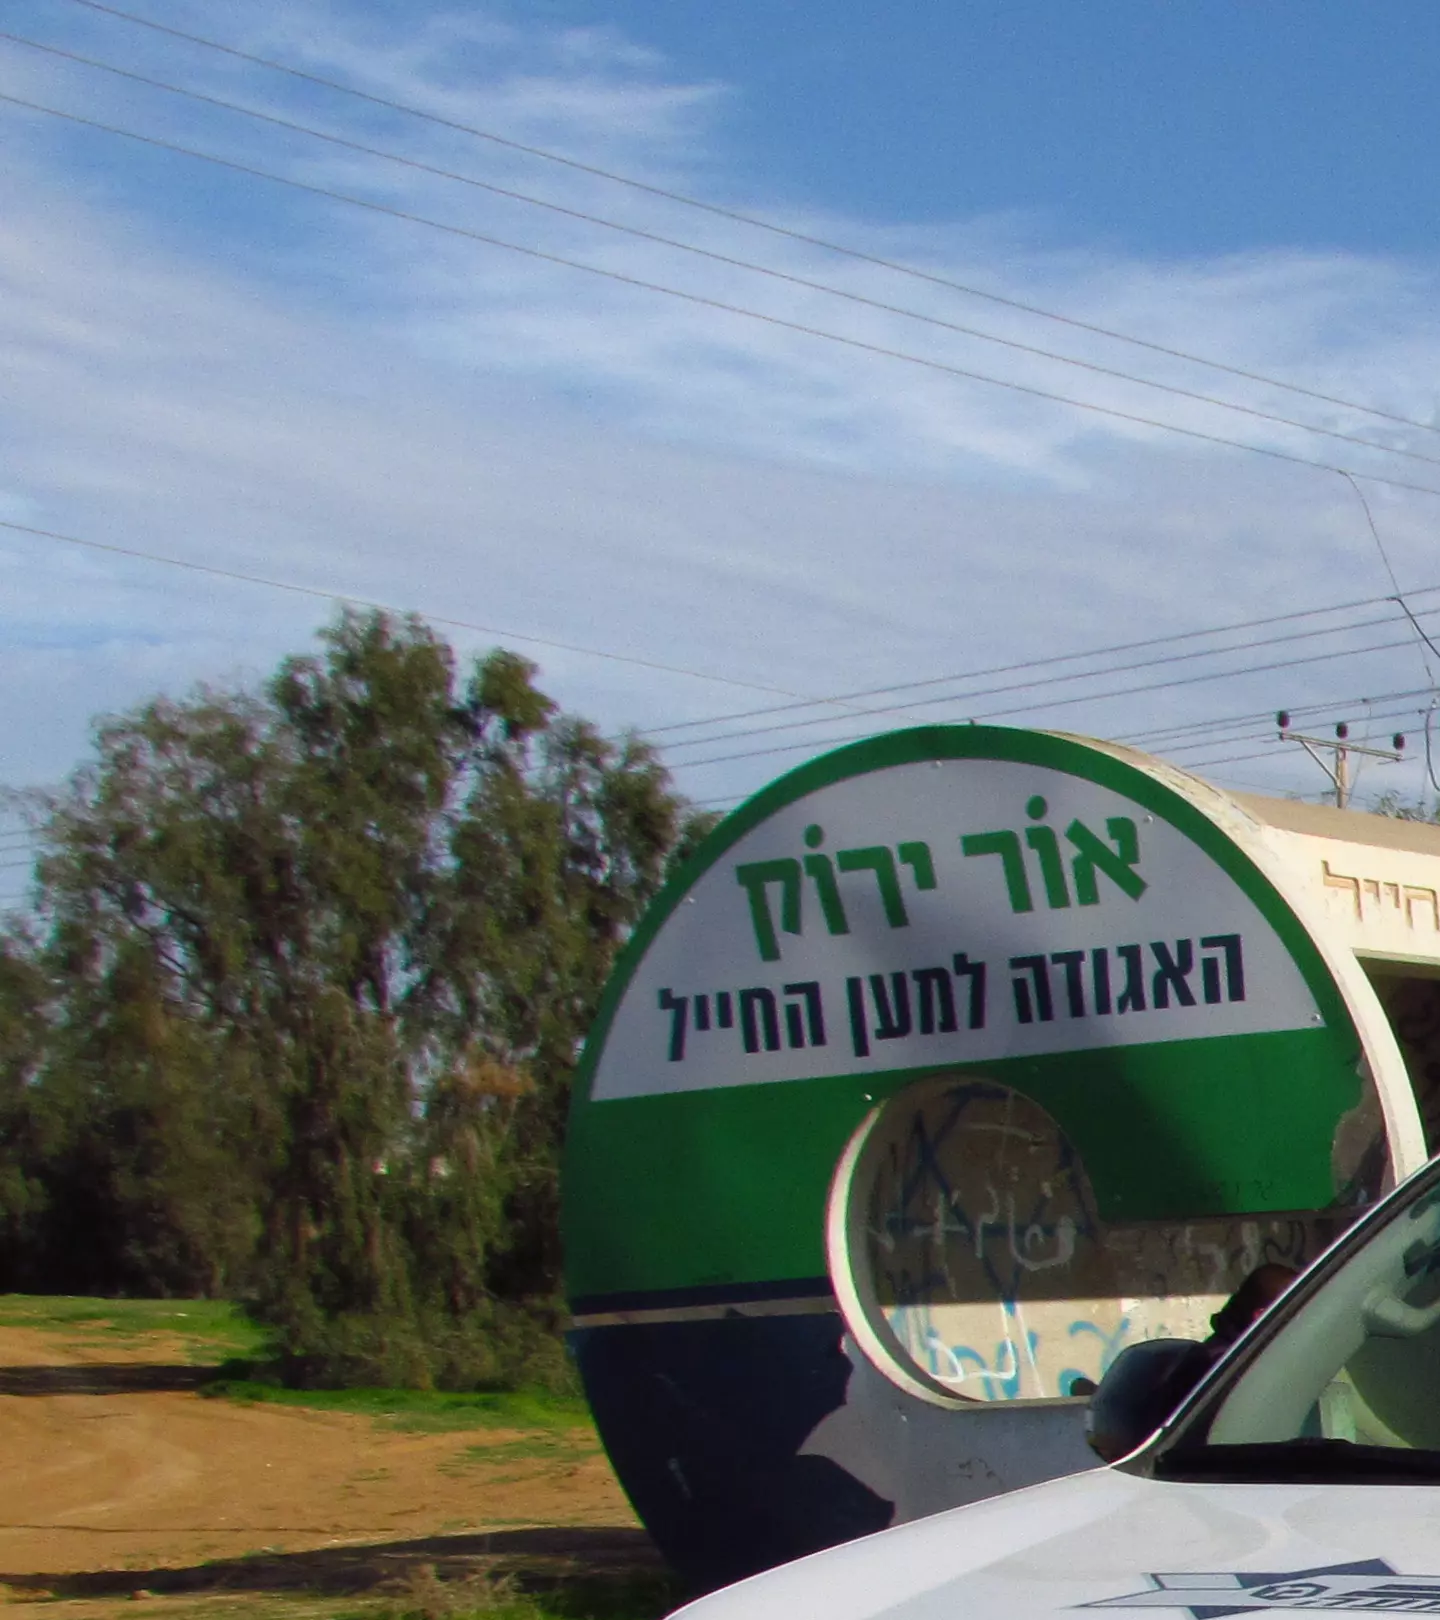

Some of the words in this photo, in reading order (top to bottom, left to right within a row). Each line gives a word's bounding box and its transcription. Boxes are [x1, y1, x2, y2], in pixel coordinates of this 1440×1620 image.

[656, 980, 825, 1064] החייל
[845, 952, 987, 1058] למען
[1009, 932, 1247, 1026] האגודה
